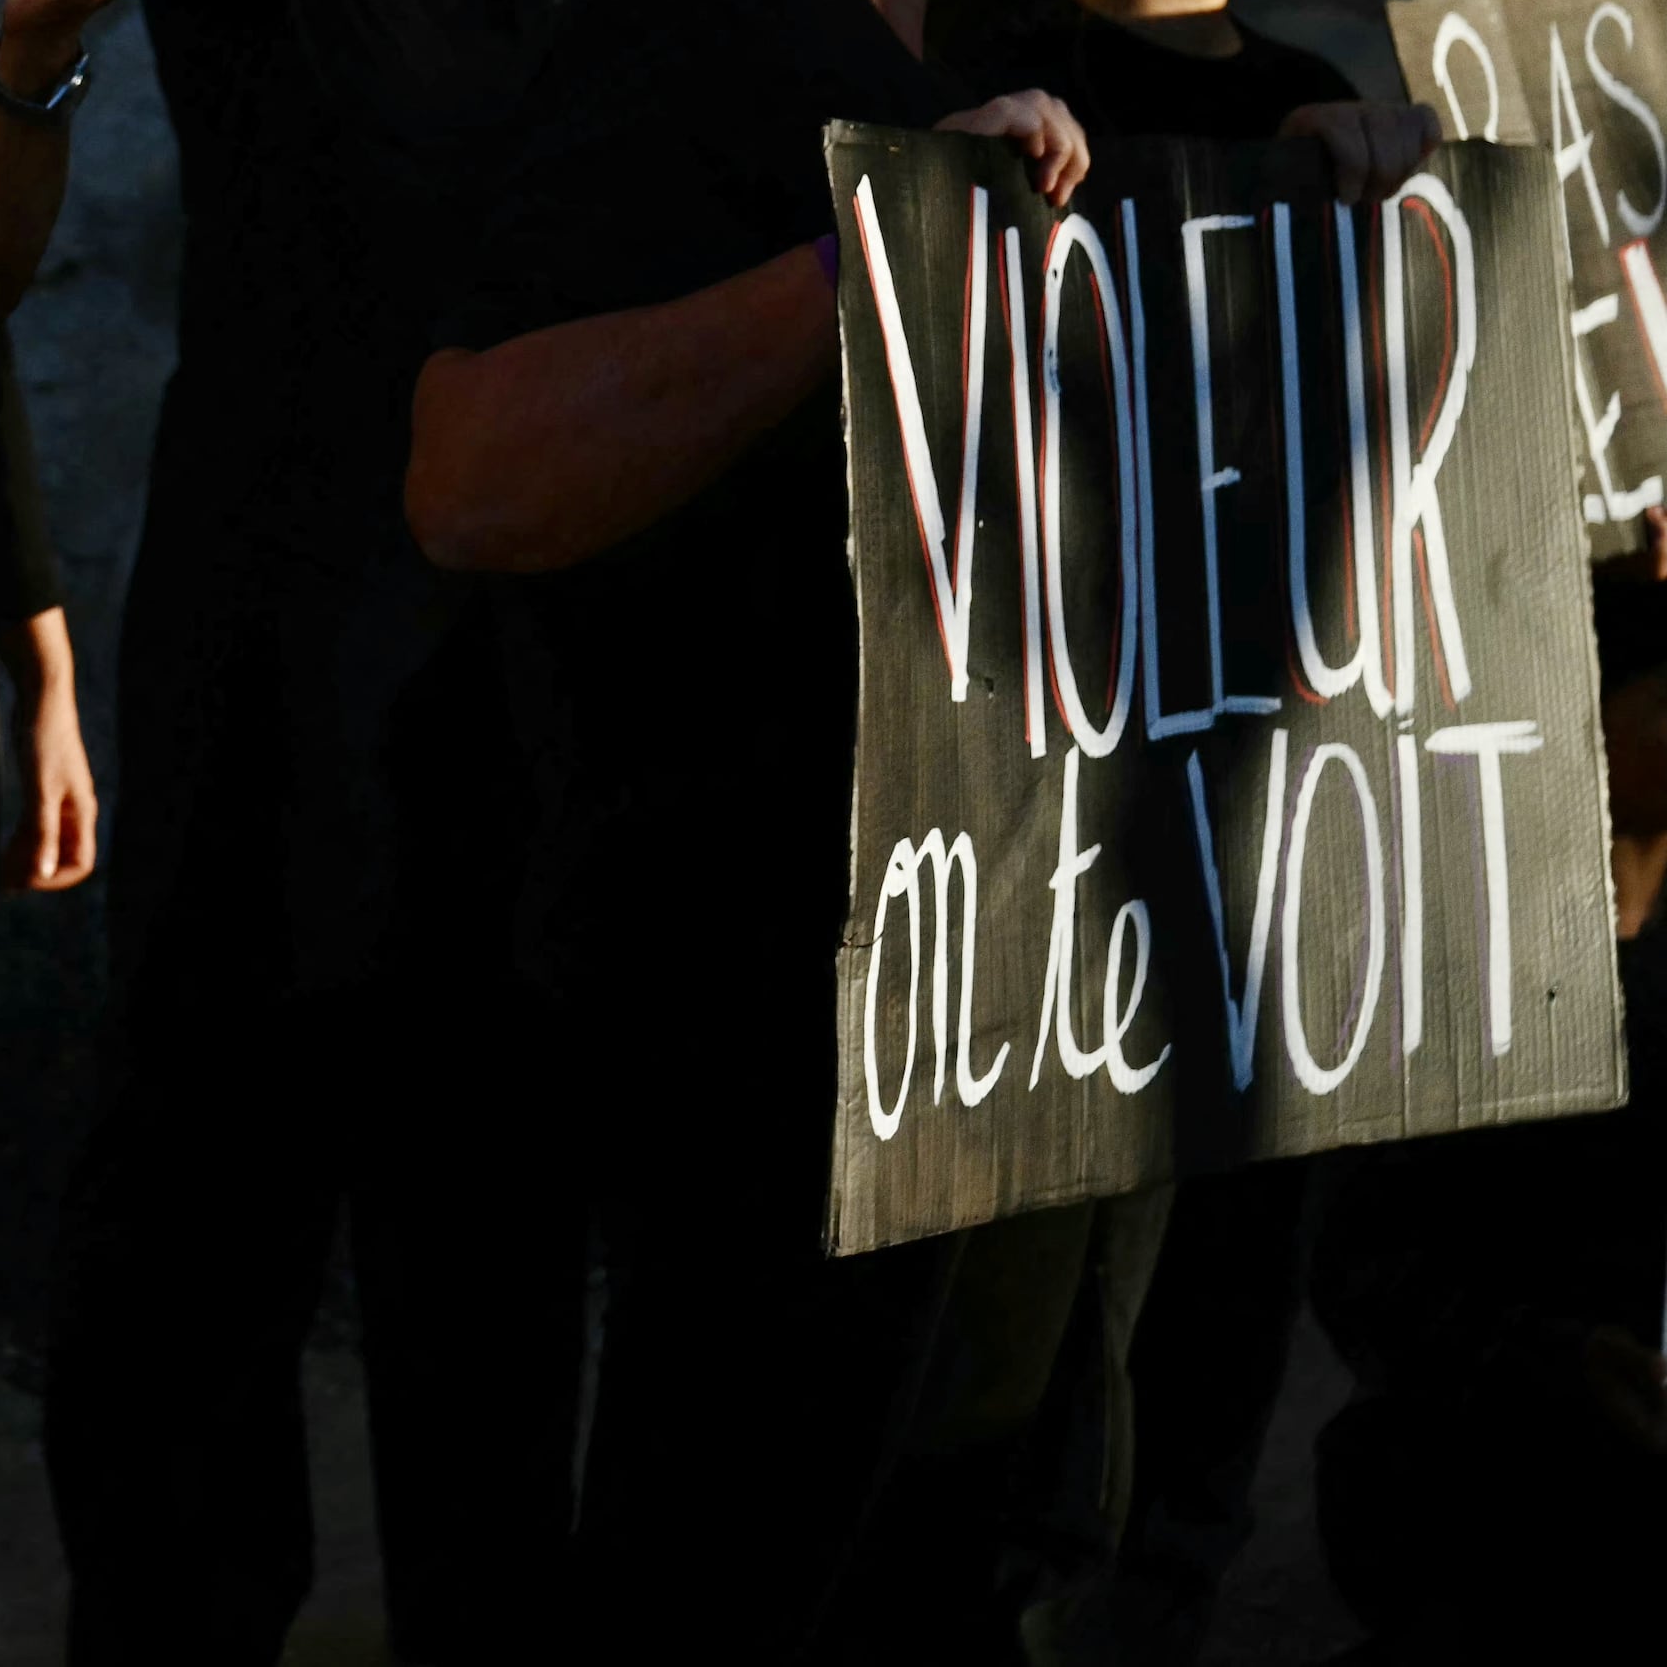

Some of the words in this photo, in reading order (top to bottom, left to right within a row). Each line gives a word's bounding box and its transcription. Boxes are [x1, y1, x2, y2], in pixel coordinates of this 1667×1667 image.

[852, 172, 1471, 759] VIOLEUR
[867, 828, 1009, 1140] on
[1029, 746, 1171, 1094] te
[1187, 720, 1545, 1094] VOIT
